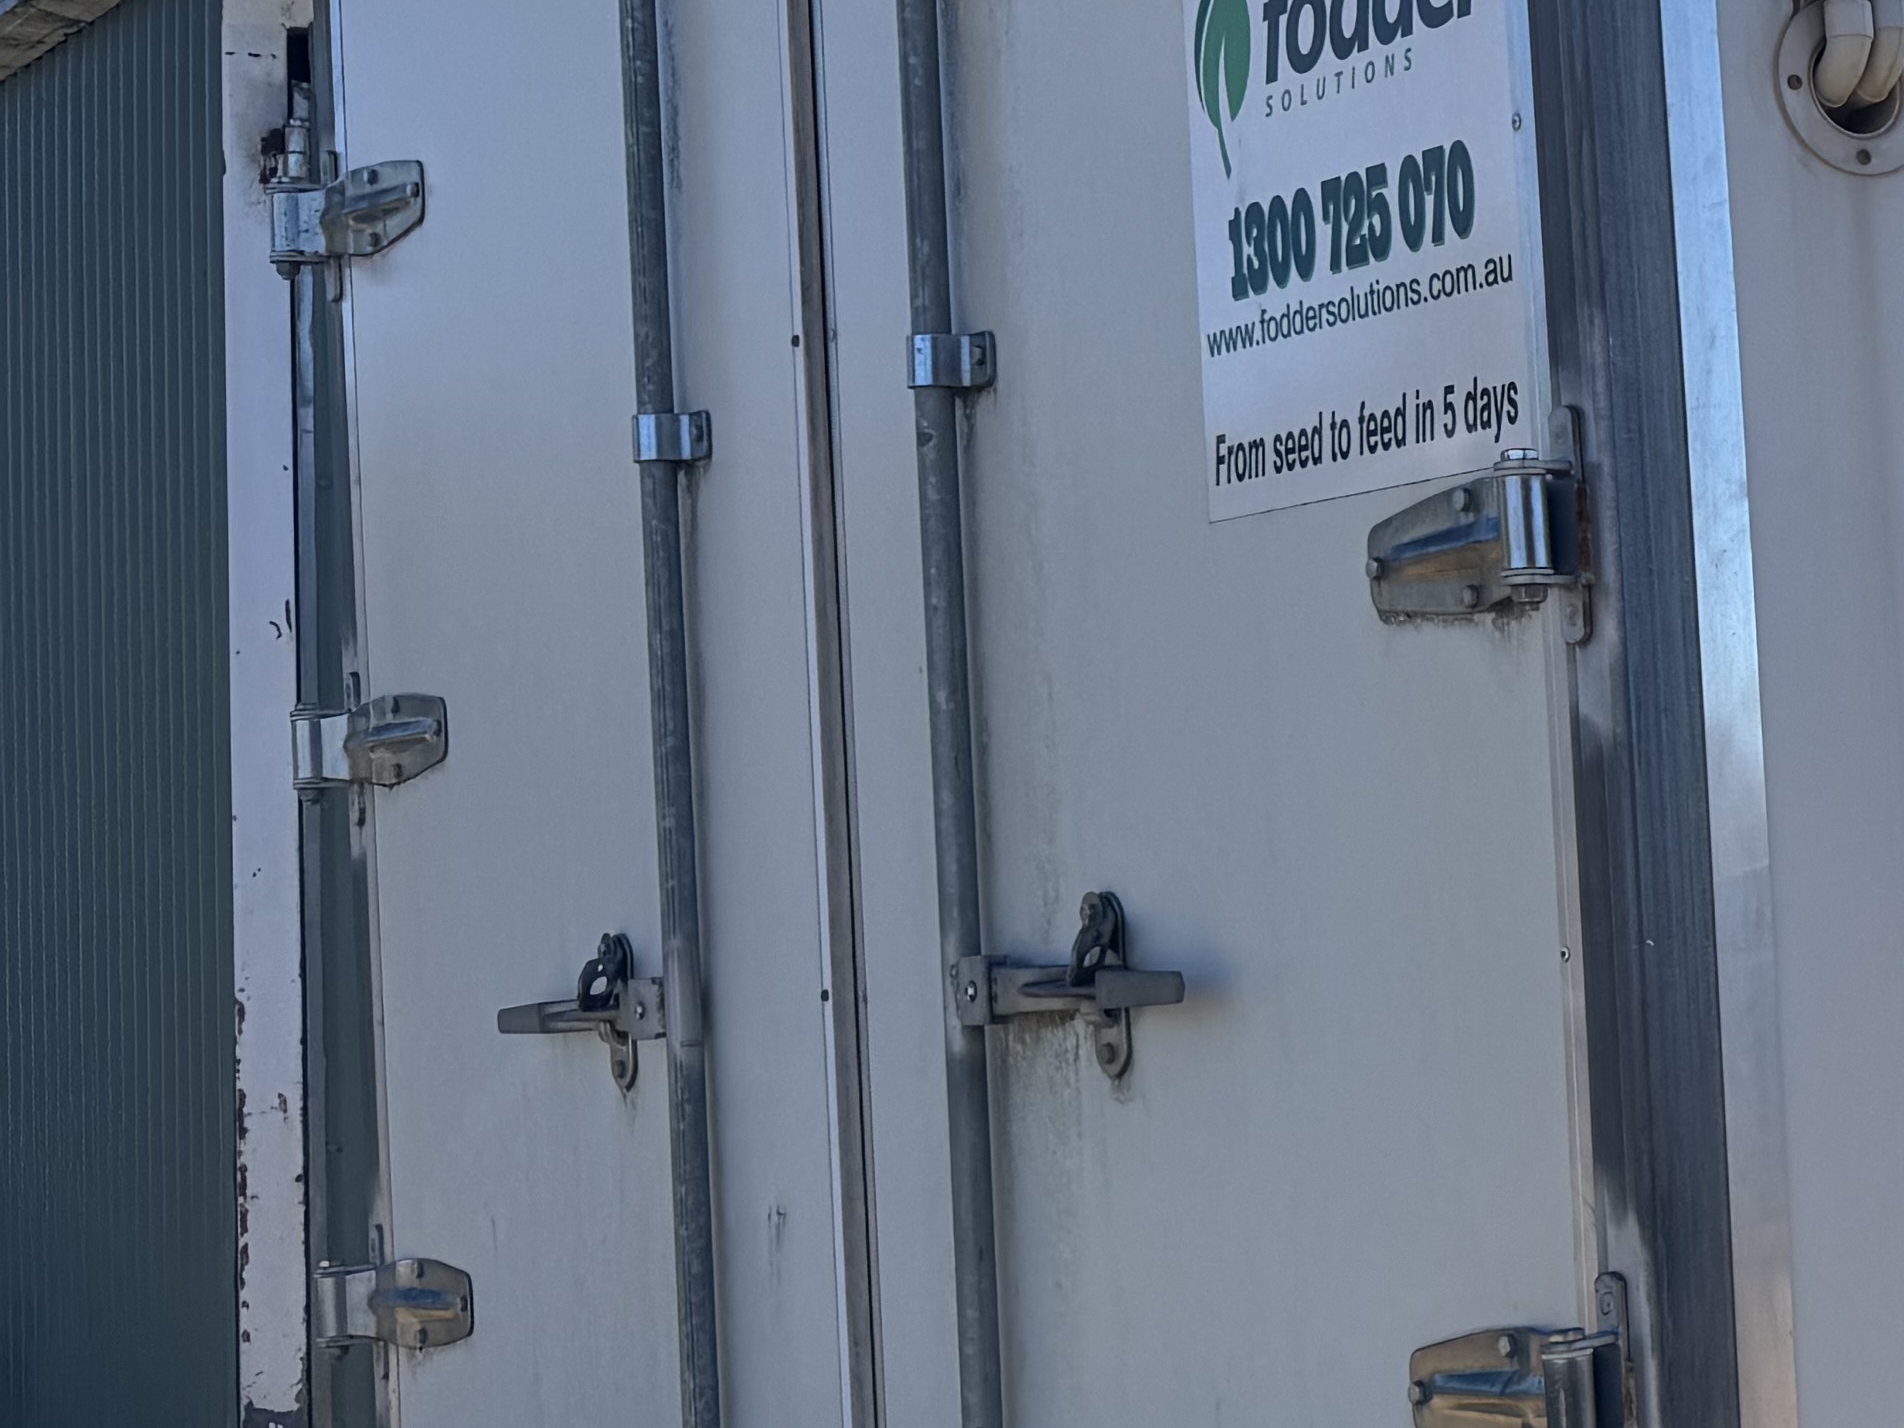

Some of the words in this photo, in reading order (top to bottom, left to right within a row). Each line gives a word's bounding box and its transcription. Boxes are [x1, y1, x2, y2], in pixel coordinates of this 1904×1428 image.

[1265, 47, 1413, 118] SOLUTIONS
[1228, 187, 1316, 302] 1300
[1320, 162, 1393, 275] 725
[1399, 139, 1475, 253] 070
[1207, 253, 1514, 358] www.foddersolutions.com.au
[1215, 433, 1266, 487] From
[1273, 411, 1323, 475] seed
[1330, 410, 1352, 463] to
[1358, 392, 1407, 456] feed
[1415, 389, 1435, 445] in
[1443, 384, 1456, 439] 5
[1464, 376, 1519, 443] days
